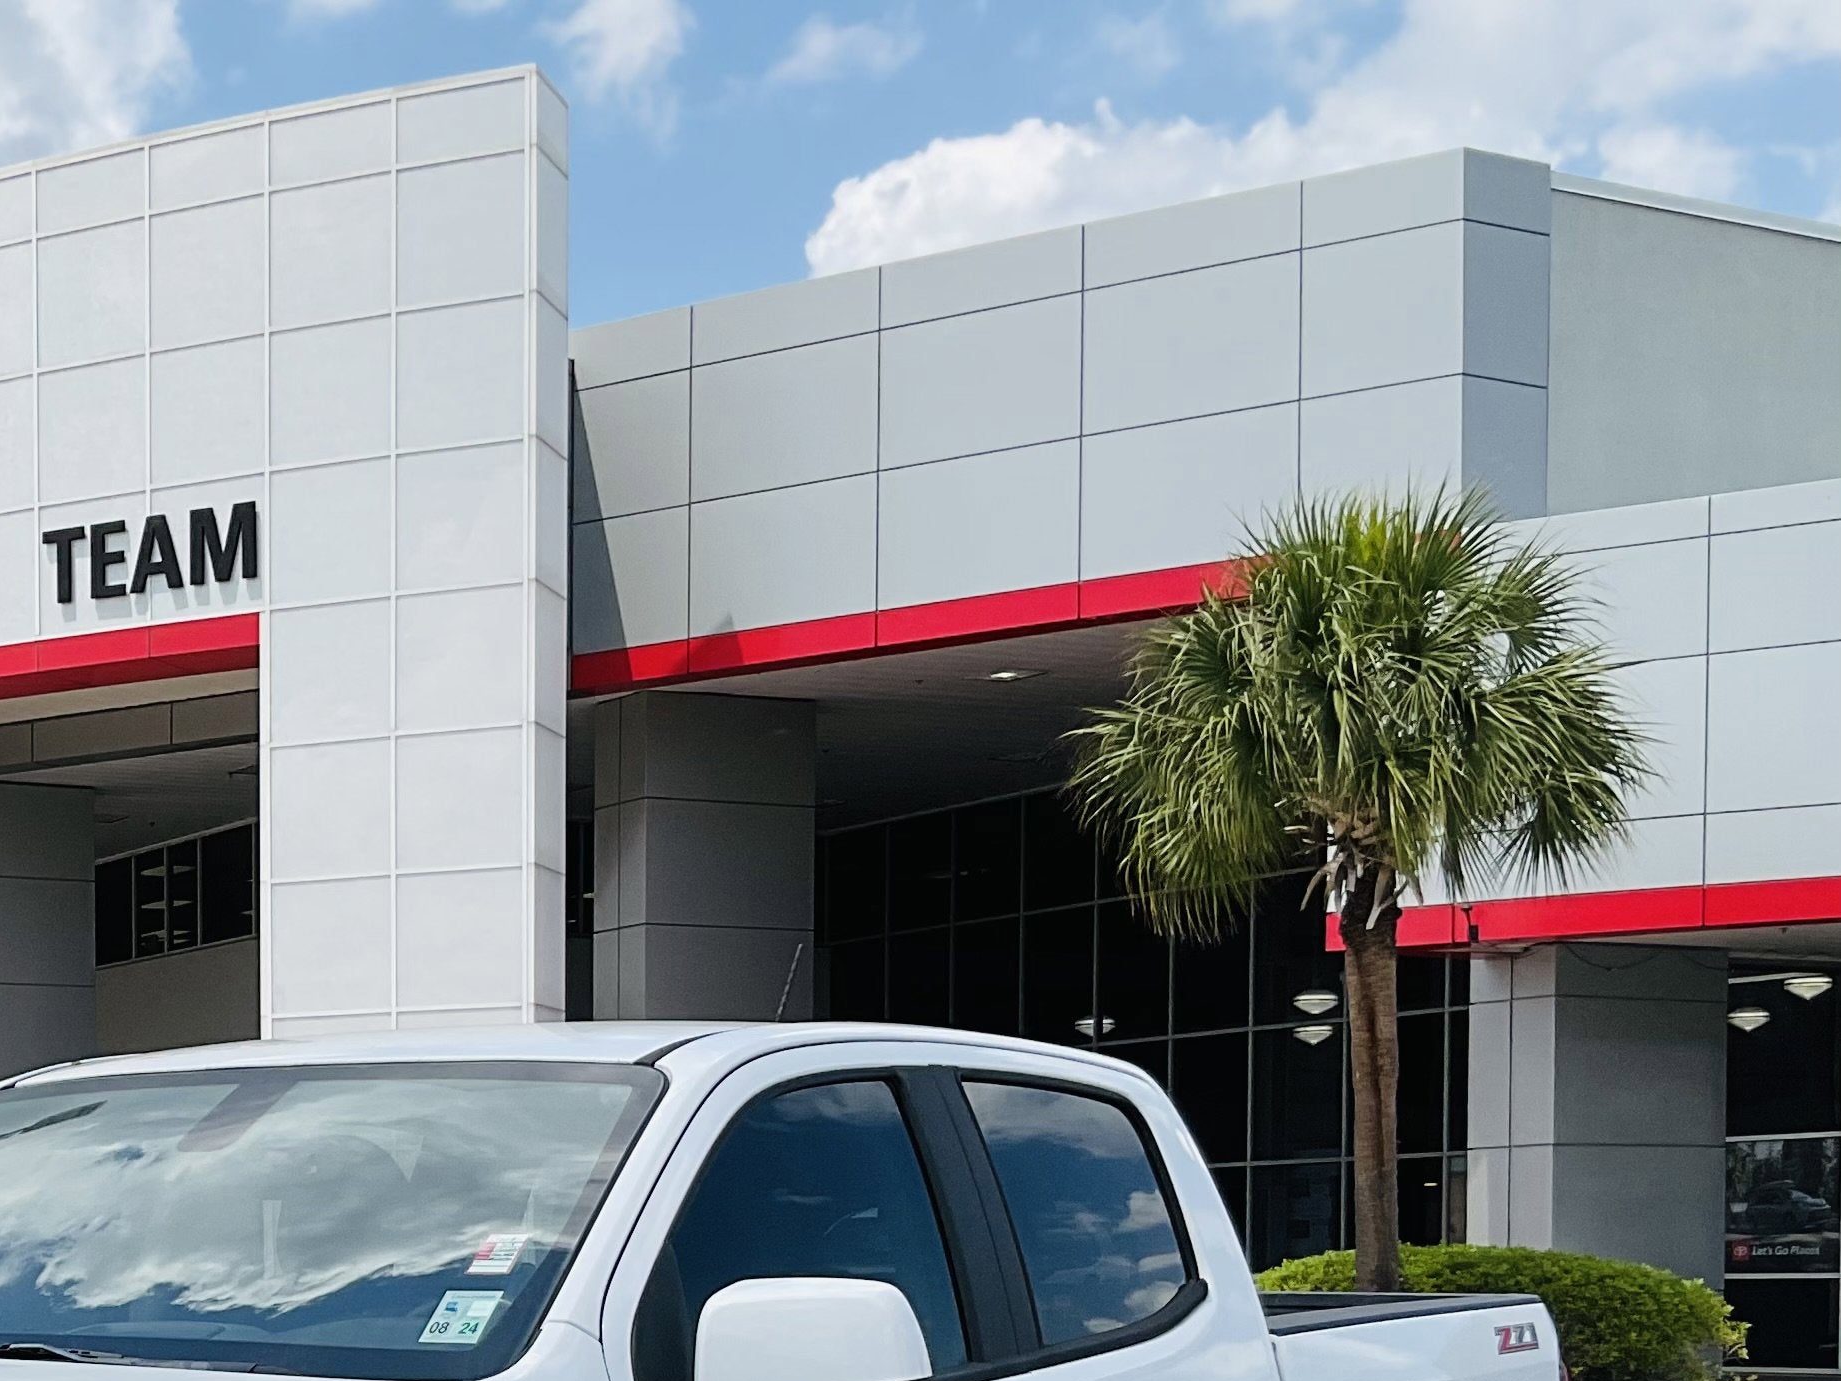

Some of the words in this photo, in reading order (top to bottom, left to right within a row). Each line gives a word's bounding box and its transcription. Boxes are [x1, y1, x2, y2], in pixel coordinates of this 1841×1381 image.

[42, 501, 258, 603] TEAM
[1752, 1245, 1772, 1256] Let's
[1774, 1245, 1789, 1256] Go
[429, 1321, 450, 1334] 08
[458, 1322, 479, 1335] 24
[1493, 1322, 1539, 1355] Z71
